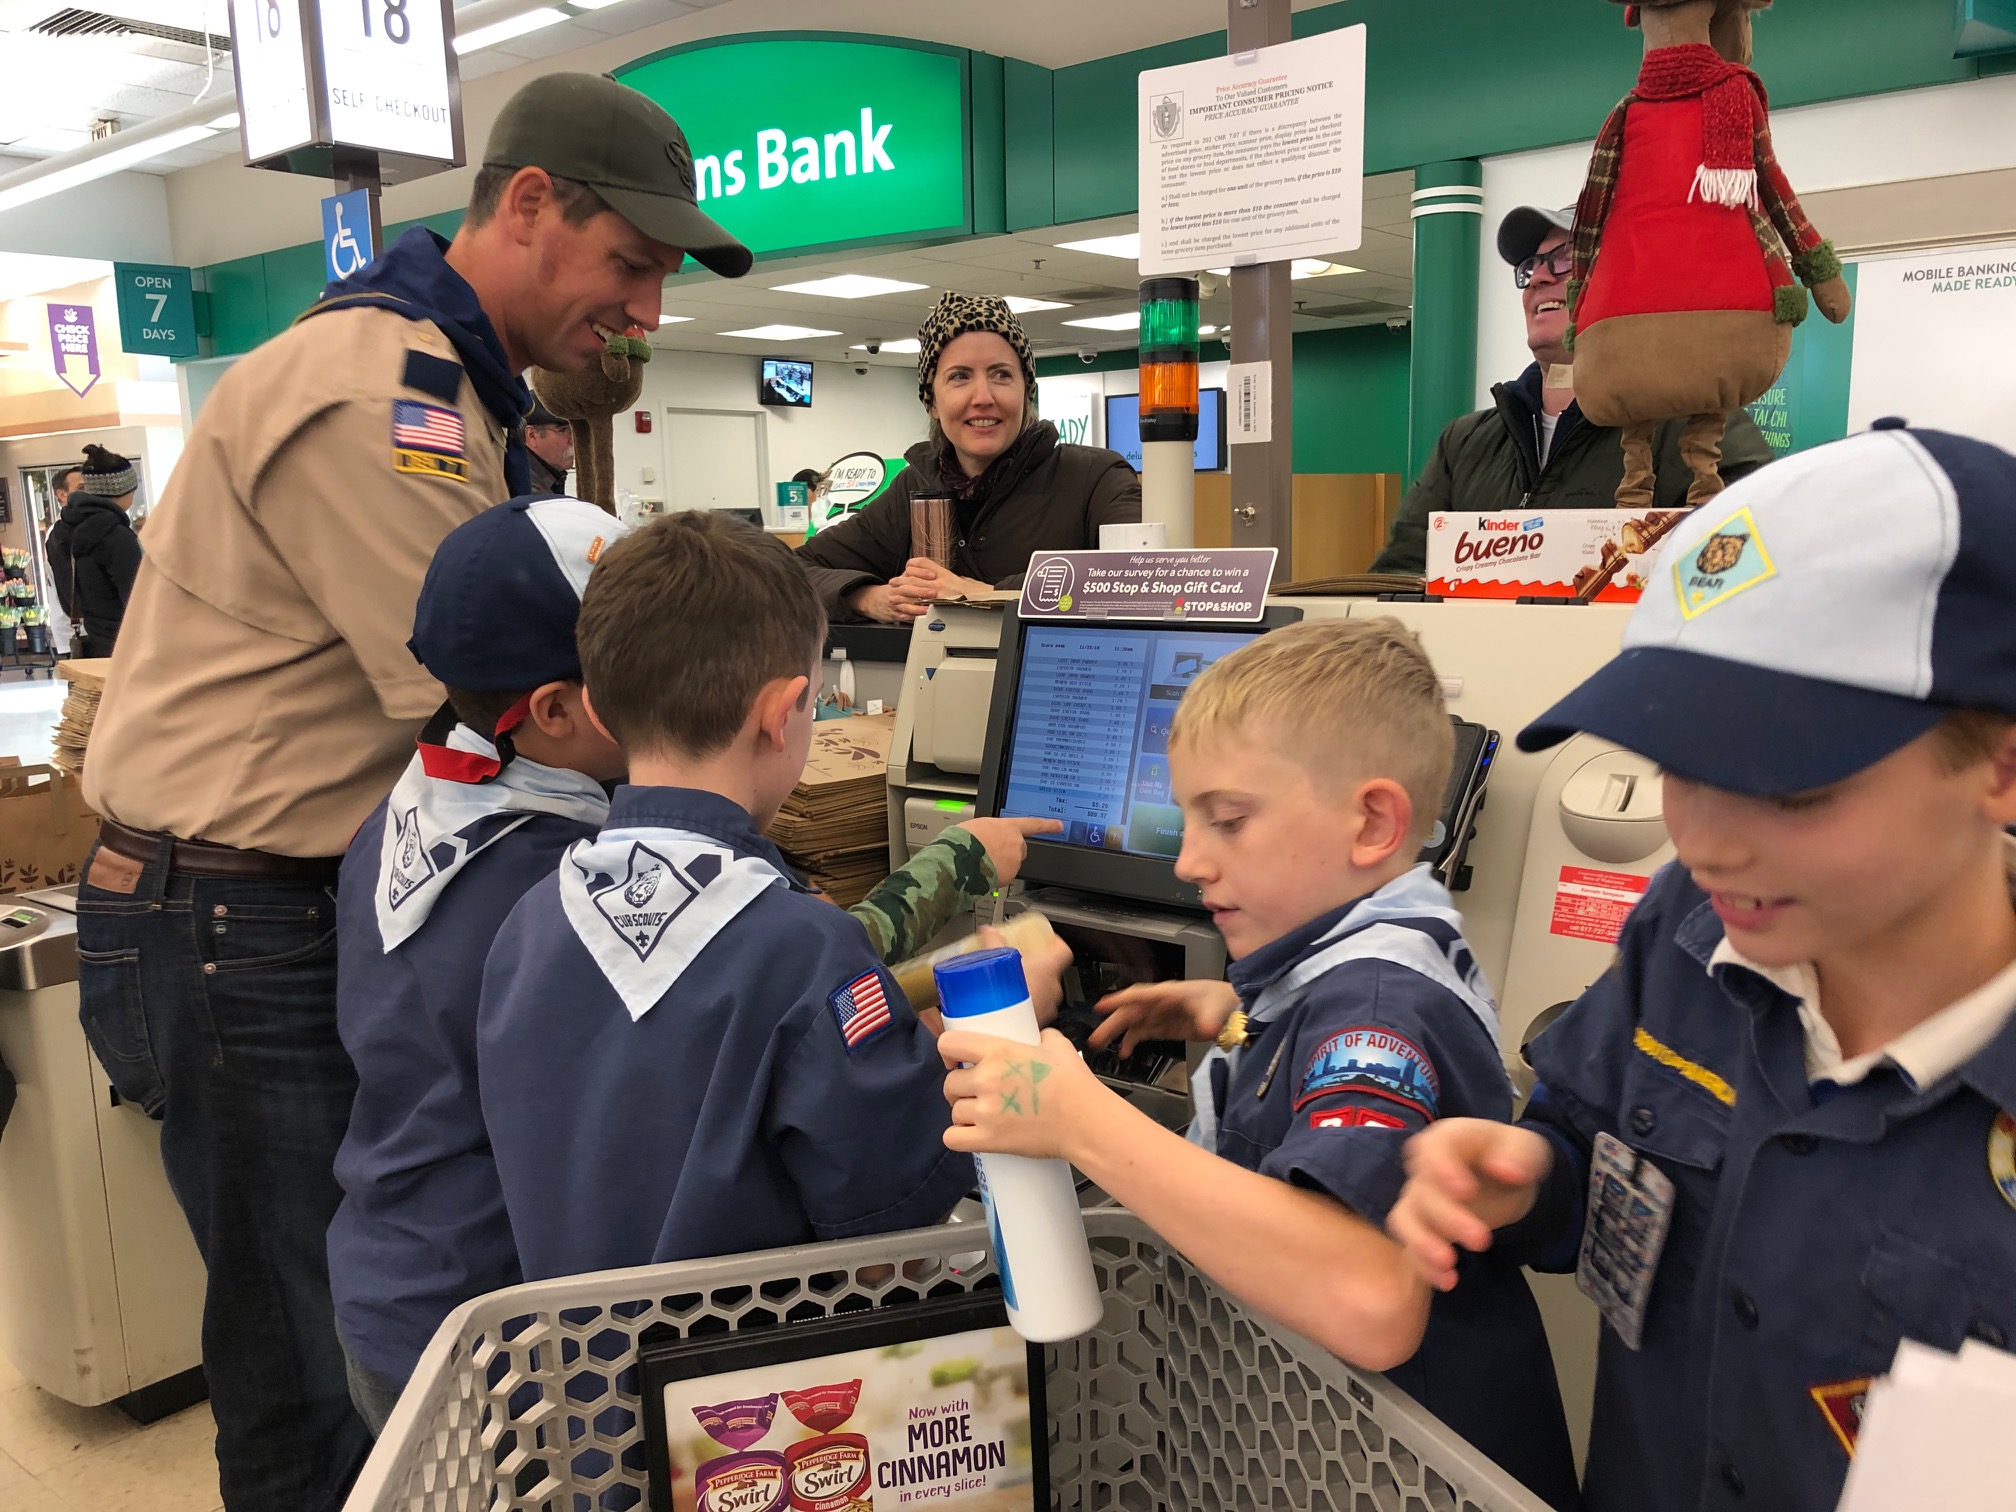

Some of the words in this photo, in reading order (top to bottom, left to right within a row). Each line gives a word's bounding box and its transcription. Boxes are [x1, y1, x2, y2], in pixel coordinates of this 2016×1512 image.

[362, 0, 411, 45] 18
[1231, 81, 1256, 90] Accuracy
[1258, 75, 1287, 84] Guarantee
[1236, 88, 1256, 96] Valued
[1258, 84, 1288, 93] Customers
[332, 88, 364, 108] SELF
[376, 95, 447, 124] CHECKOUT
[1190, 102, 1231, 115] IMPORTANT
[1233, 96, 1273, 107] CONSUMER
[1275, 88, 1304, 98] PRICING
[1306, 81, 1333, 92] NOTICE
[1204, 111, 1223, 121] PRICE
[1224, 106, 1259, 117] ACCURACY
[1259, 98, 1299, 110] GUARANTEE
[756, 107, 896, 190] Bank
[134, 276, 172, 289] OPEN
[1903, 267, 1953, 282] MOBILE
[1932, 279, 1971, 294] MADE
[1975, 276, 2016, 289] READY
[145, 294, 168, 322] 7
[54, 323, 90, 335] CHECK
[143, 328, 176, 340] DAYS
[58, 334, 89, 344] PRICE
[61, 343, 89, 354] HERE
[1752, 389, 1786, 406] ISURE
[1754, 409, 1769, 426] TAI
[1771, 411, 1787, 427] CHI
[844, 468, 868, 480] READY
[868, 468, 877, 479] TO
[1478, 517, 1519, 531] kinder
[1454, 532, 1544, 564] bueno
[1130, 555, 1144, 566] Help
[1175, 556, 1189, 566] you
[1189, 554, 1211, 563] better.
[1455, 563, 1474, 572] Crispy
[1474, 560, 1497, 569] Creamy
[1498, 555, 1528, 564] Chocolate
[1087, 567, 1106, 576] Take
[1123, 569, 1154, 578] survey
[1154, 567, 1169, 576] for
[1176, 568, 1210, 576] chance
[1212, 567, 1223, 576] to
[1224, 567, 1241, 576] win
[1242, 568, 1249, 576] a
[1082, 581, 1110, 593] $500
[1111, 581, 1138, 595] Stop
[1140, 581, 1149, 592] &
[1150, 581, 1181, 595] Shop
[1183, 581, 1208, 593] Gift
[1209, 581, 1243, 593] Card.
[1689, 577, 1725, 590] BEAR
[910, 822, 928, 830] EPSON
[1156, 827, 1178, 837] Finish
[1344, 1034, 1362, 1047] OF
[908, 1405, 938, 1420] Now
[940, 1398, 968, 1414] with
[907, 1414, 972, 1452] MORE
[801, 1454, 838, 1469] PEPPERIDGE
[839, 1451, 857, 1459] FARM
[877, 1440, 1006, 1489] CINNAMON
[715, 1472, 754, 1487] PEPPERIDGE
[755, 1469, 774, 1478] FARM
[804, 1465, 853, 1494] Swirl
[900, 1488, 912, 1502] in
[915, 1484, 950, 1500] every
[954, 1475, 986, 1493] slice!
[718, 1483, 770, 1512] Swirl
[814, 1496, 848, 1510] Cinnamon
